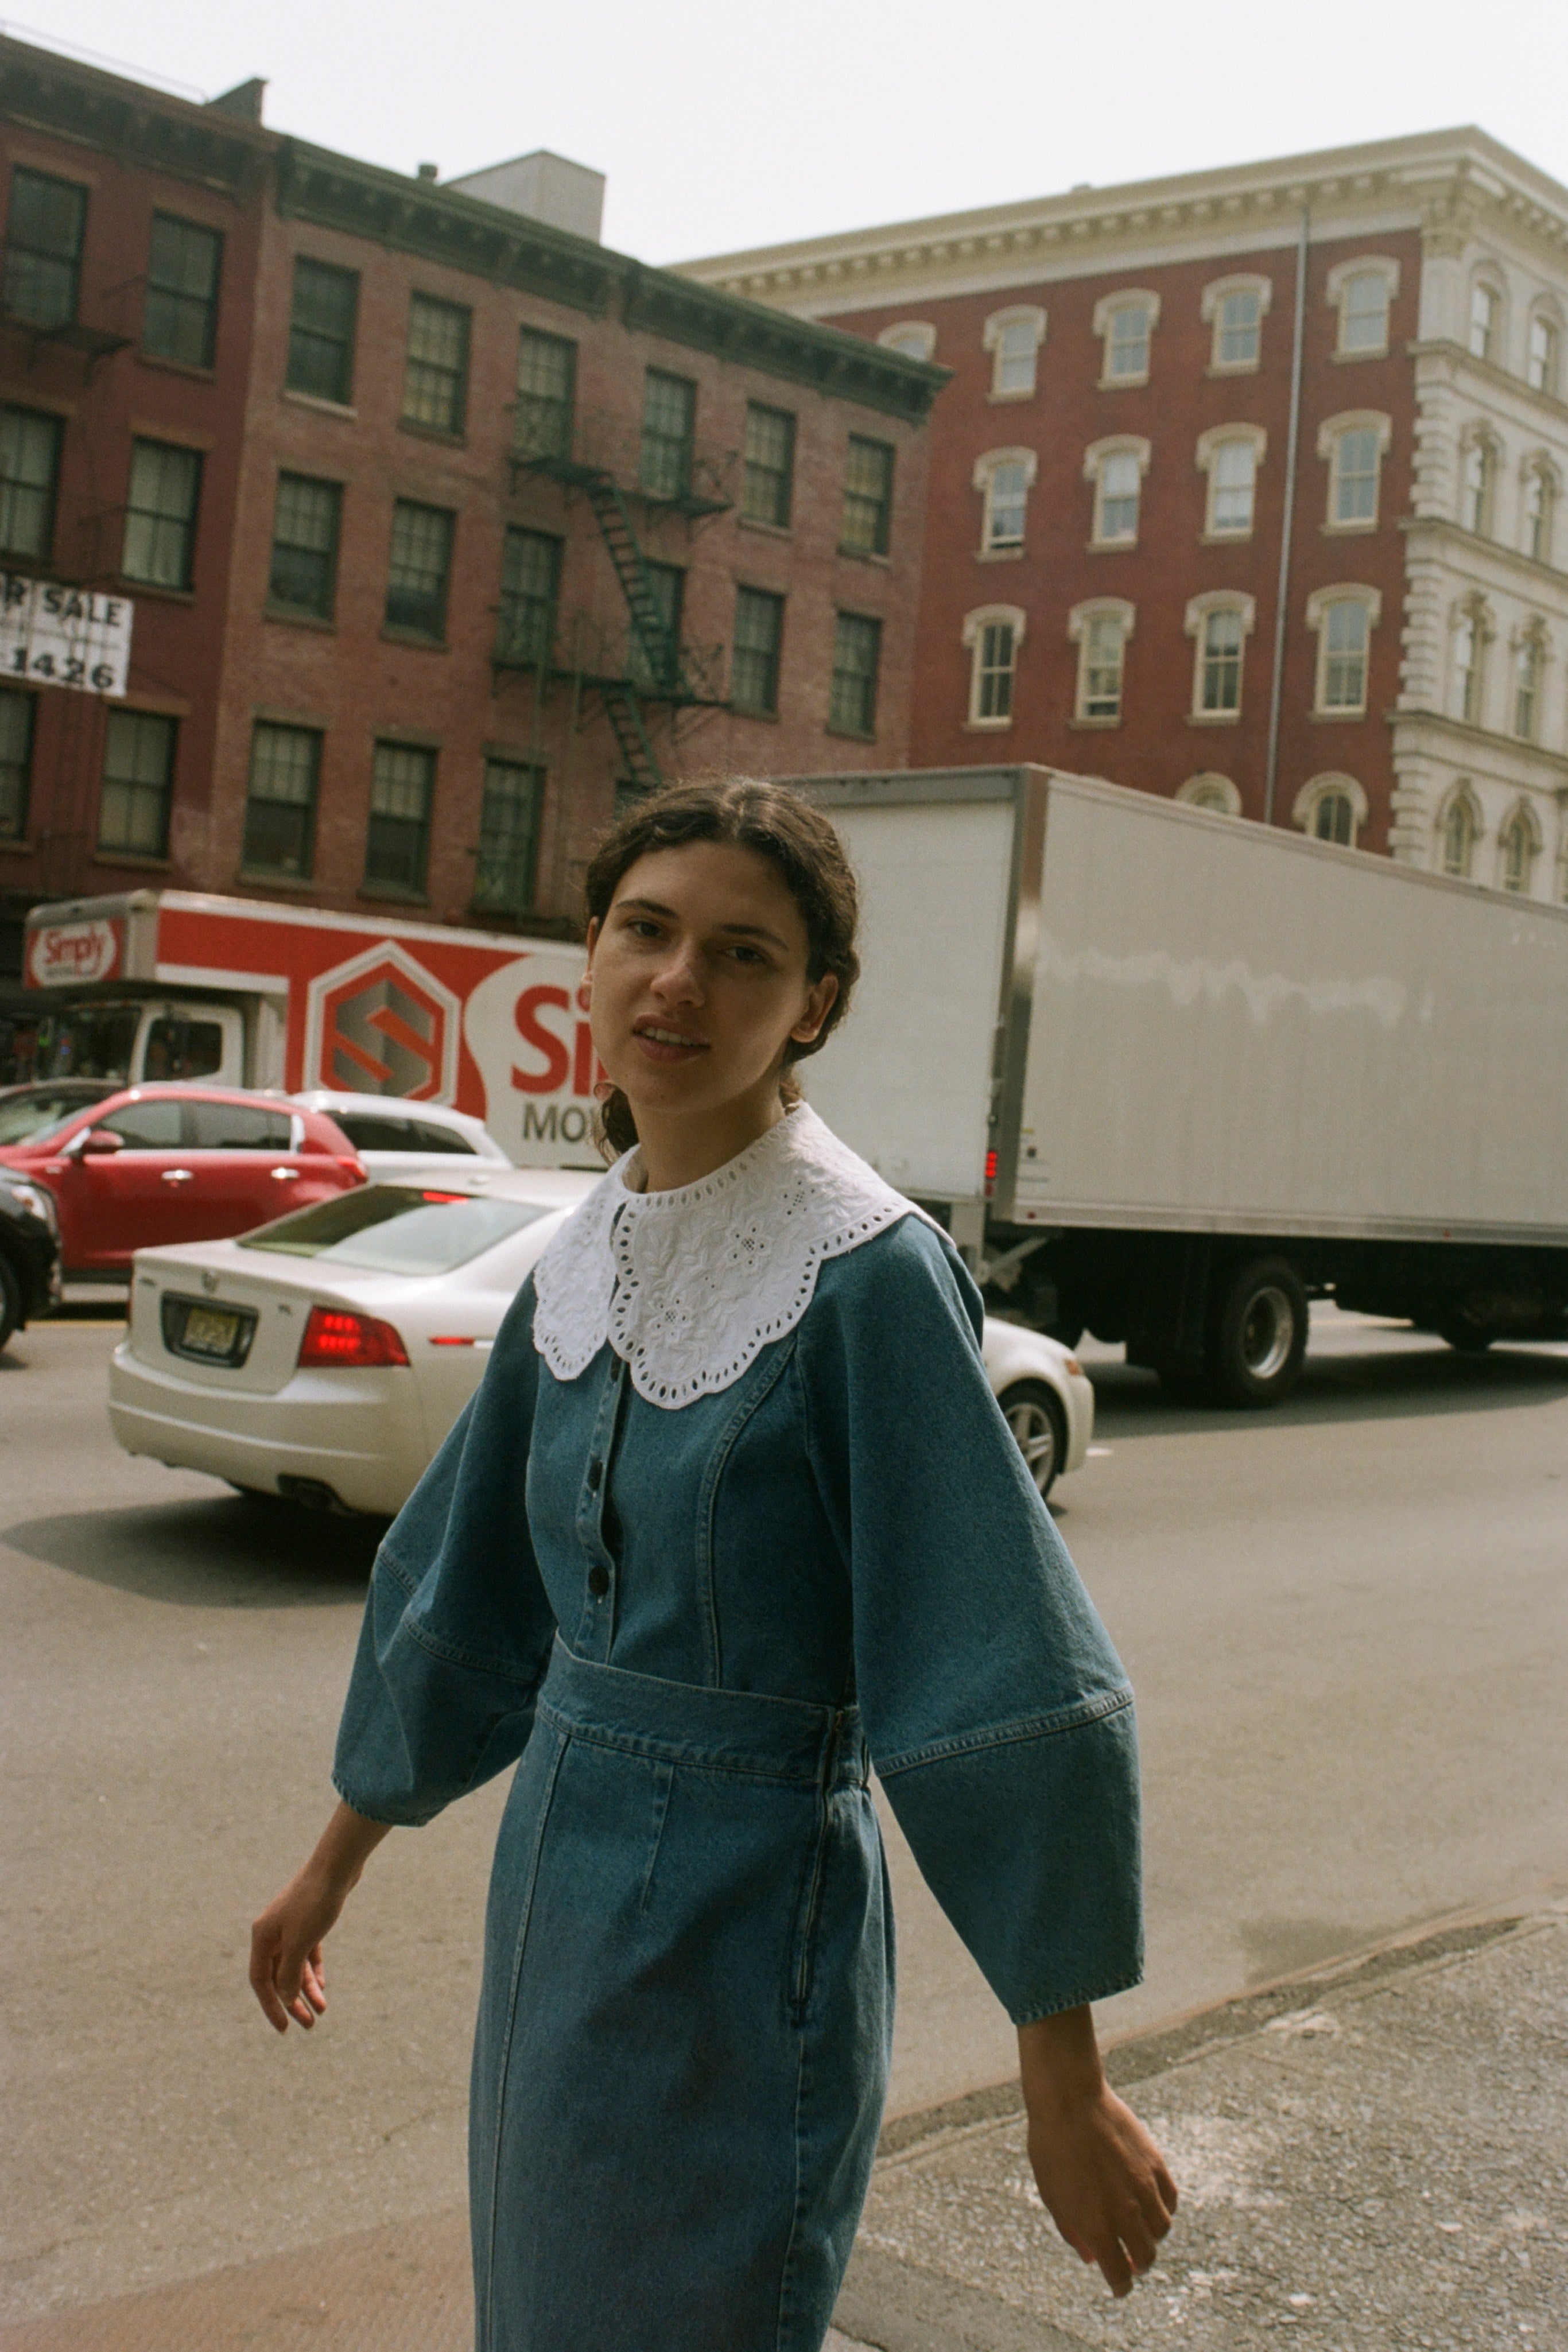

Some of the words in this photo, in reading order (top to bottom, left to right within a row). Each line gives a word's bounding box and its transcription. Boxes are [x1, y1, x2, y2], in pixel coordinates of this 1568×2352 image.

[43, 585, 121, 627] SALE
[13, 647, 114, 689] 1426
[511, 984, 610, 1097] Si
[523, 1102, 597, 1143] MO
